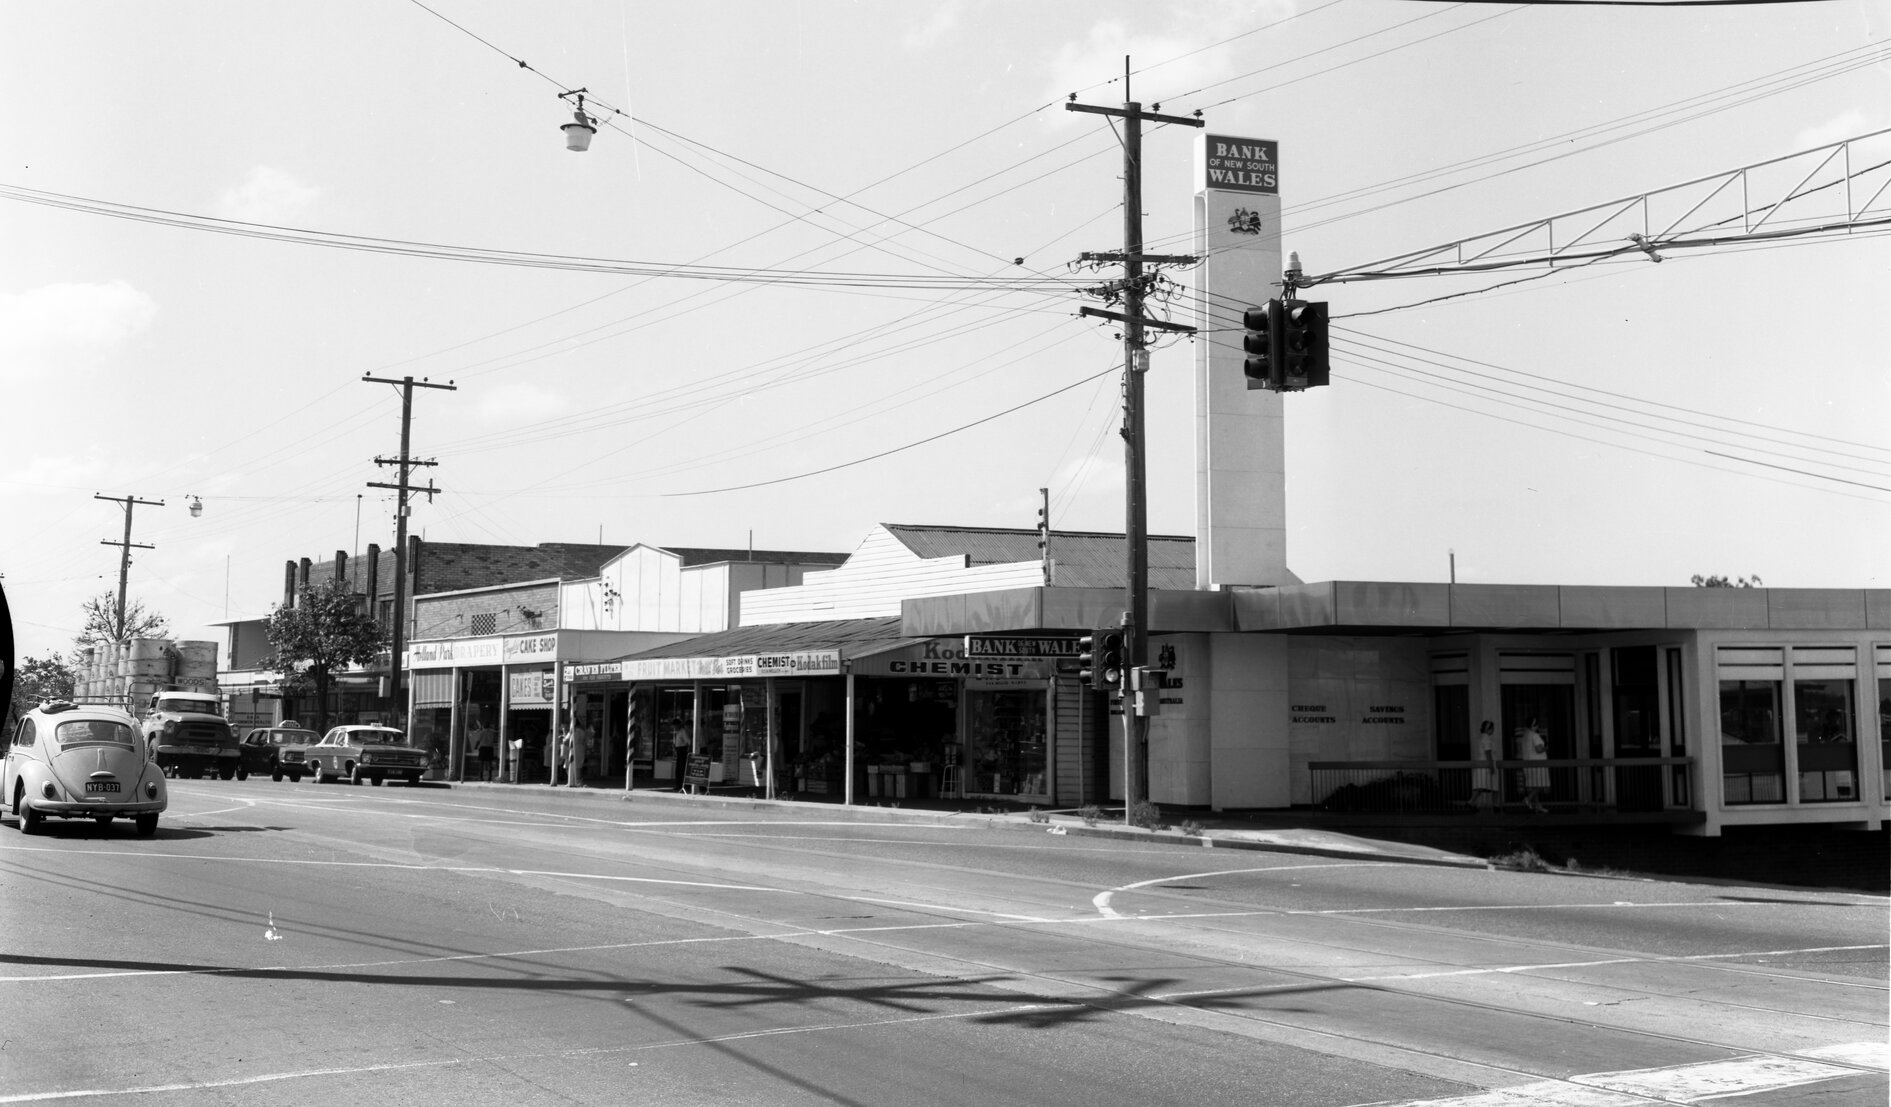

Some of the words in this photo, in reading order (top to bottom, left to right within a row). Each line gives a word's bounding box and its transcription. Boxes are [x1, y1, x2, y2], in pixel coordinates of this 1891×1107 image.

[1216, 142, 1269, 161] BANK
[1209, 158, 1221, 166] OF
[1224, 159, 1243, 169] NEW
[1247, 161, 1275, 172] SOUTH
[1208, 168, 1276, 188] WALES
[520, 639, 537, 654] CAKE
[539, 637, 556, 653] SHOP
[924, 641, 968, 660] Kod
[971, 640, 1018, 655] BANK
[1038, 640, 1081, 655] WALE
[757, 656, 790, 668] CHEMIST
[797, 654, 820, 671] Kodak
[821, 655, 838, 670] film
[890, 661, 1024, 676] CHEMIST
[178, 678, 205, 686] WOODS
[1370, 705, 1405, 713] SAVINGS
[1292, 716, 1336, 724] ACCOUNTS
